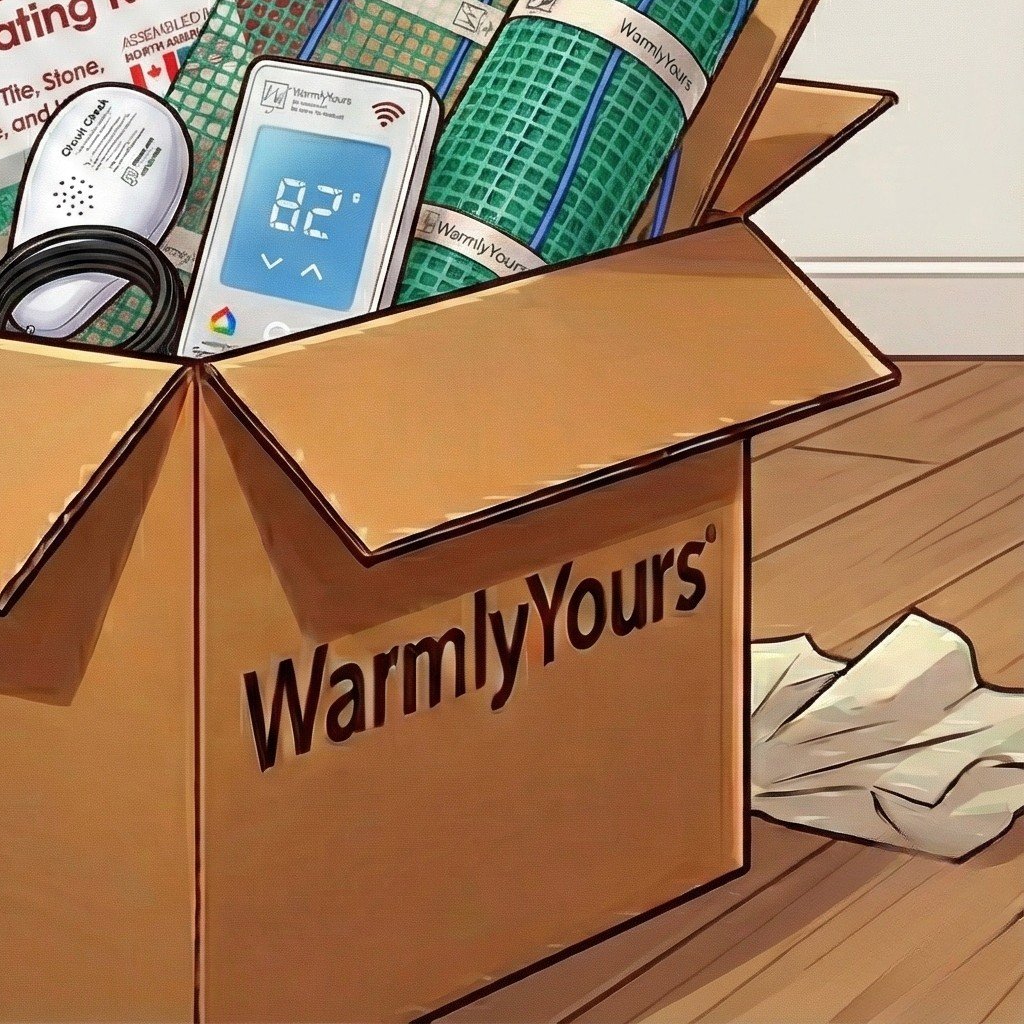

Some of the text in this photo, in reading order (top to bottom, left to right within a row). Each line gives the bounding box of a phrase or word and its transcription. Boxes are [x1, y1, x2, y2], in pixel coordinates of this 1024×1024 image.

[42, 60, 105, 92] Stone,
[619, 17, 694, 92] WarmlyYours
[12, 102, 51, 133] and
[243, 523, 718, 774] WarmlyYours
